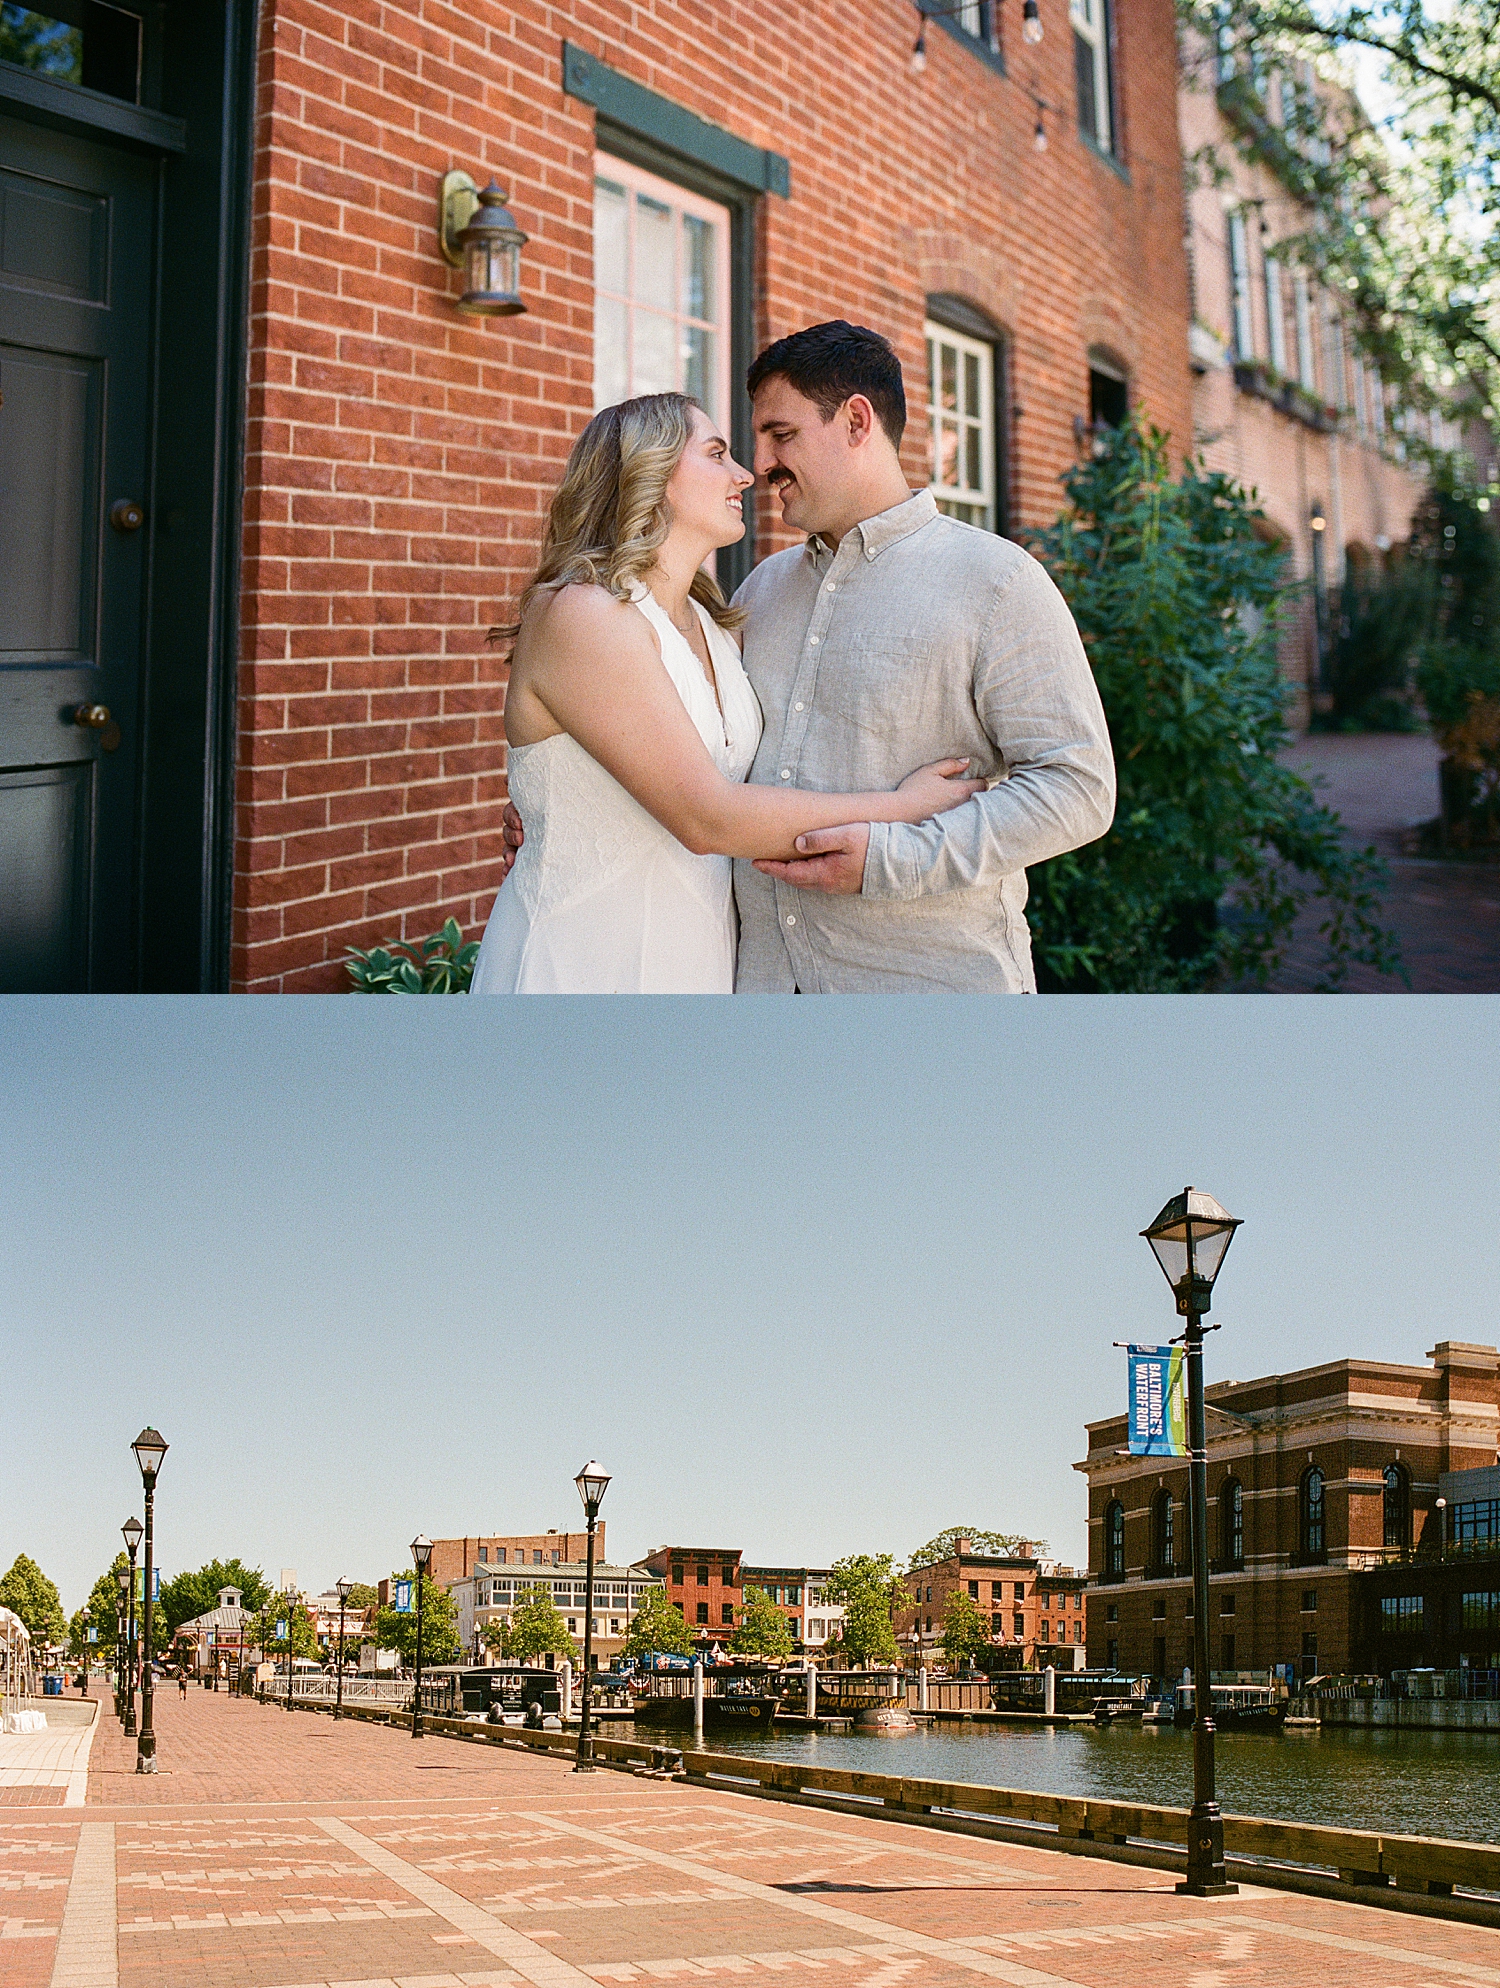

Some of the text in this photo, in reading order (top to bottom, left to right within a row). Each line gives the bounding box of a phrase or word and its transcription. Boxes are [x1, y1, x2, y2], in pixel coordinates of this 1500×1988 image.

[1135, 1363, 1149, 1437] WATERFRONT
[1149, 1363, 1163, 1436] BALTIMORE'S
[229, 1663, 239, 1681] TAXI
